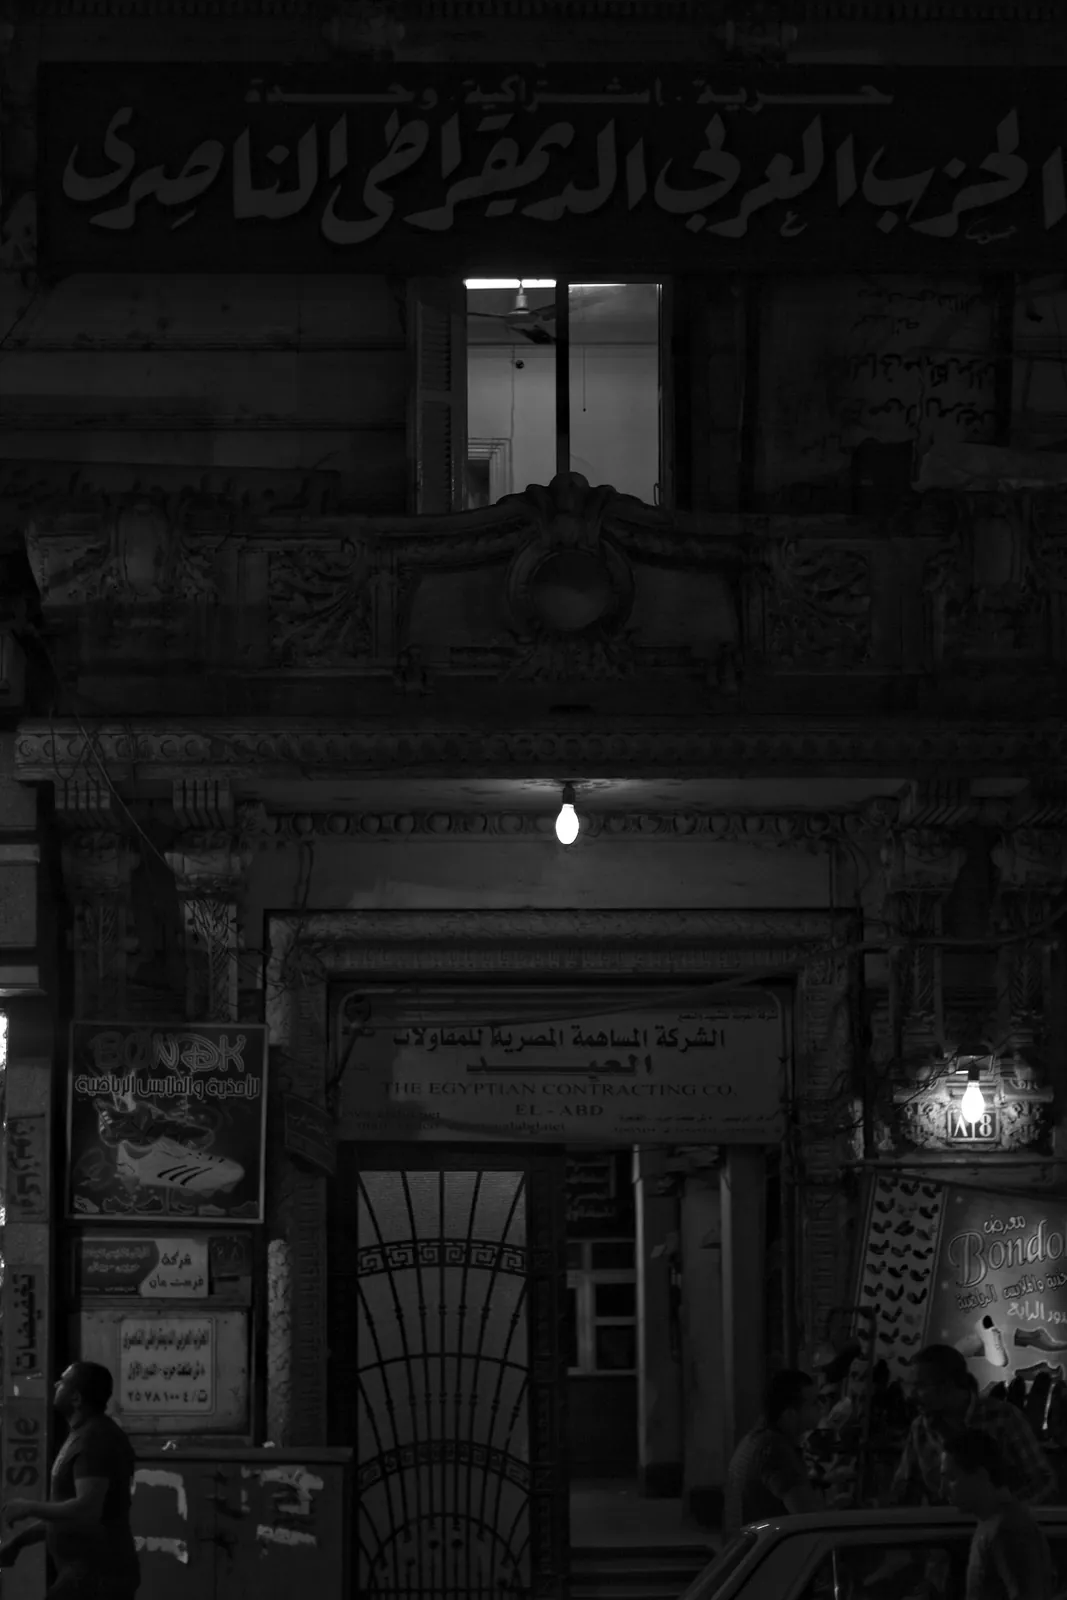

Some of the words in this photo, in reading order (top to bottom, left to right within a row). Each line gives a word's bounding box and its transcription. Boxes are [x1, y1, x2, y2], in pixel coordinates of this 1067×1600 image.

[570, 1024, 648, 1048] المساهمة
[654, 1024, 726, 1053] الشركة
[381, 1081, 422, 1096] THE
[428, 1081, 537, 1097] EGYPTIAN
[542, 1082, 697, 1097] CONTRACTING
[979, 1113, 992, 1137] 8
[983, 1214, 1026, 1235] معرض
[948, 1219, 1067, 1288] Bondo
[6, 1417, 40, 1487] Sale
